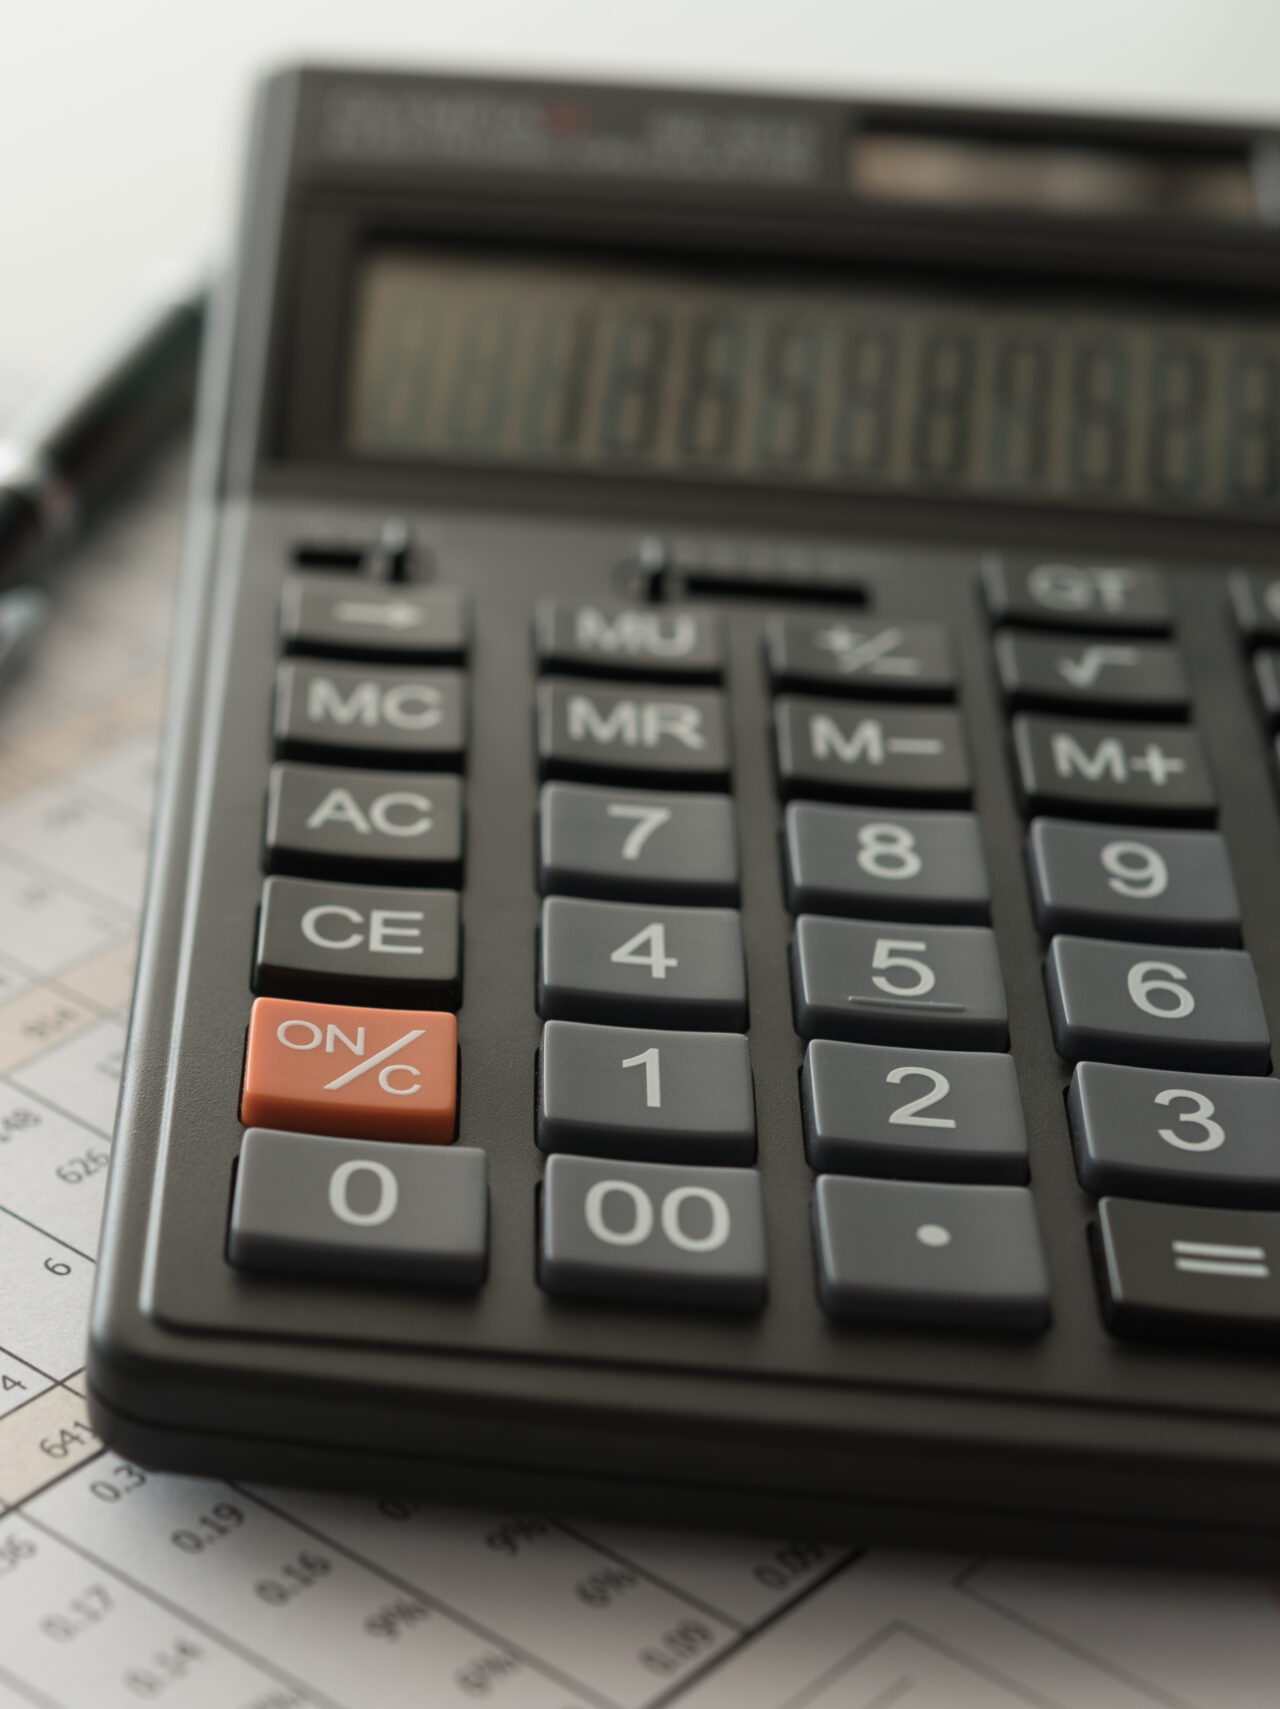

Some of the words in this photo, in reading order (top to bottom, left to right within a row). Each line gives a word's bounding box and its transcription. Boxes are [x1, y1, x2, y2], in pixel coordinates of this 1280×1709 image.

[1026, 561, 1137, 615] GT
[574, 603, 696, 657] MU
[306, 676, 444, 730] MC
[566, 695, 707, 750] MR
[1050, 732, 1186, 786] M+
[305, 787, 434, 837] AC
[606, 802, 672, 861] 7
[856, 822, 923, 880] 8
[1099, 840, 1170, 898] 9
[300, 904, 425, 955] CE
[610, 922, 678, 979] 4
[870, 938, 936, 997] 5
[1127, 960, 1196, 1020] 6
[276, 1019, 426, 1096] ON/C
[621, 1047, 662, 1108] 1
[884, 1066, 957, 1129] 2
[1153, 1088, 1226, 1152] 3
[55, 1147, 111, 1186] 626
[328, 1159, 399, 1227] 0
[584, 1179, 732, 1252] 00
[43, 1256, 73, 1278] 6
[1, 1373, 28, 1392] 4
[39, 1419, 97, 1460] 641
[88, 1463, 148, 1504] 0.3
[170, 1500, 247, 1556] 0.19
[252, 1549, 333, 1608] 0.16
